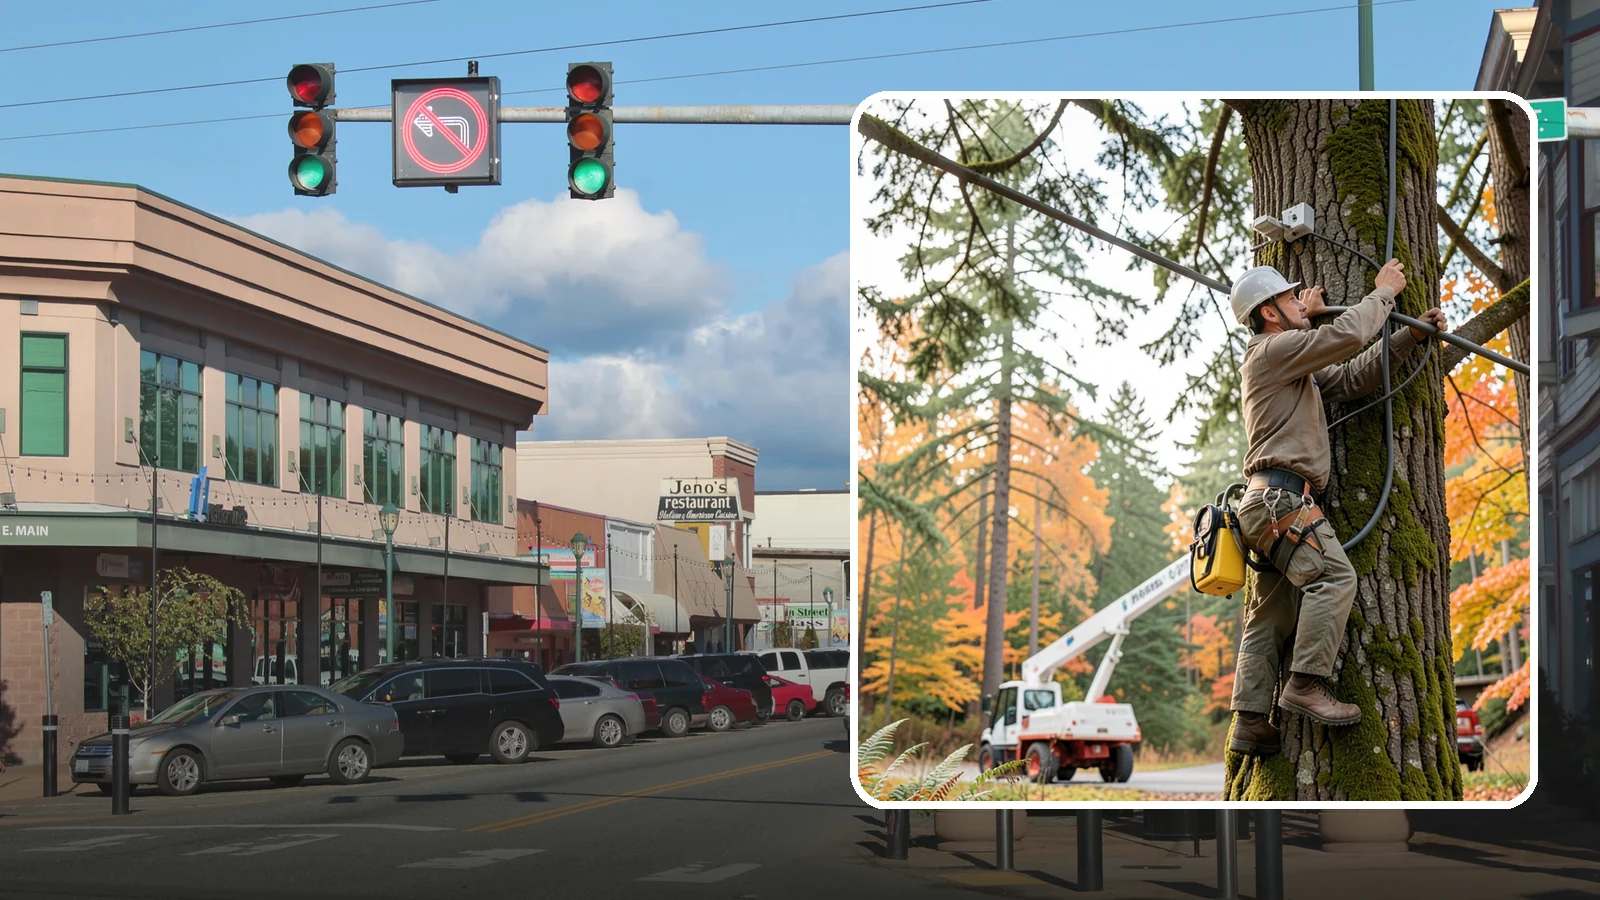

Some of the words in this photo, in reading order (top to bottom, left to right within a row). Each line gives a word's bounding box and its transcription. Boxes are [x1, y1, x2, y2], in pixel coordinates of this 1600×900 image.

[669, 480, 728, 495] Jeno's
[665, 496, 731, 509] restaurant
[658, 509, 682, 520] Italian
[685, 509, 715, 519] American
[714, 509, 738, 519] Cuisine
[2, 525, 13, 536] E.
[15, 525, 49, 536] MAIN
[797, 607, 828, 617] Street
[790, 619, 824, 627] lass
